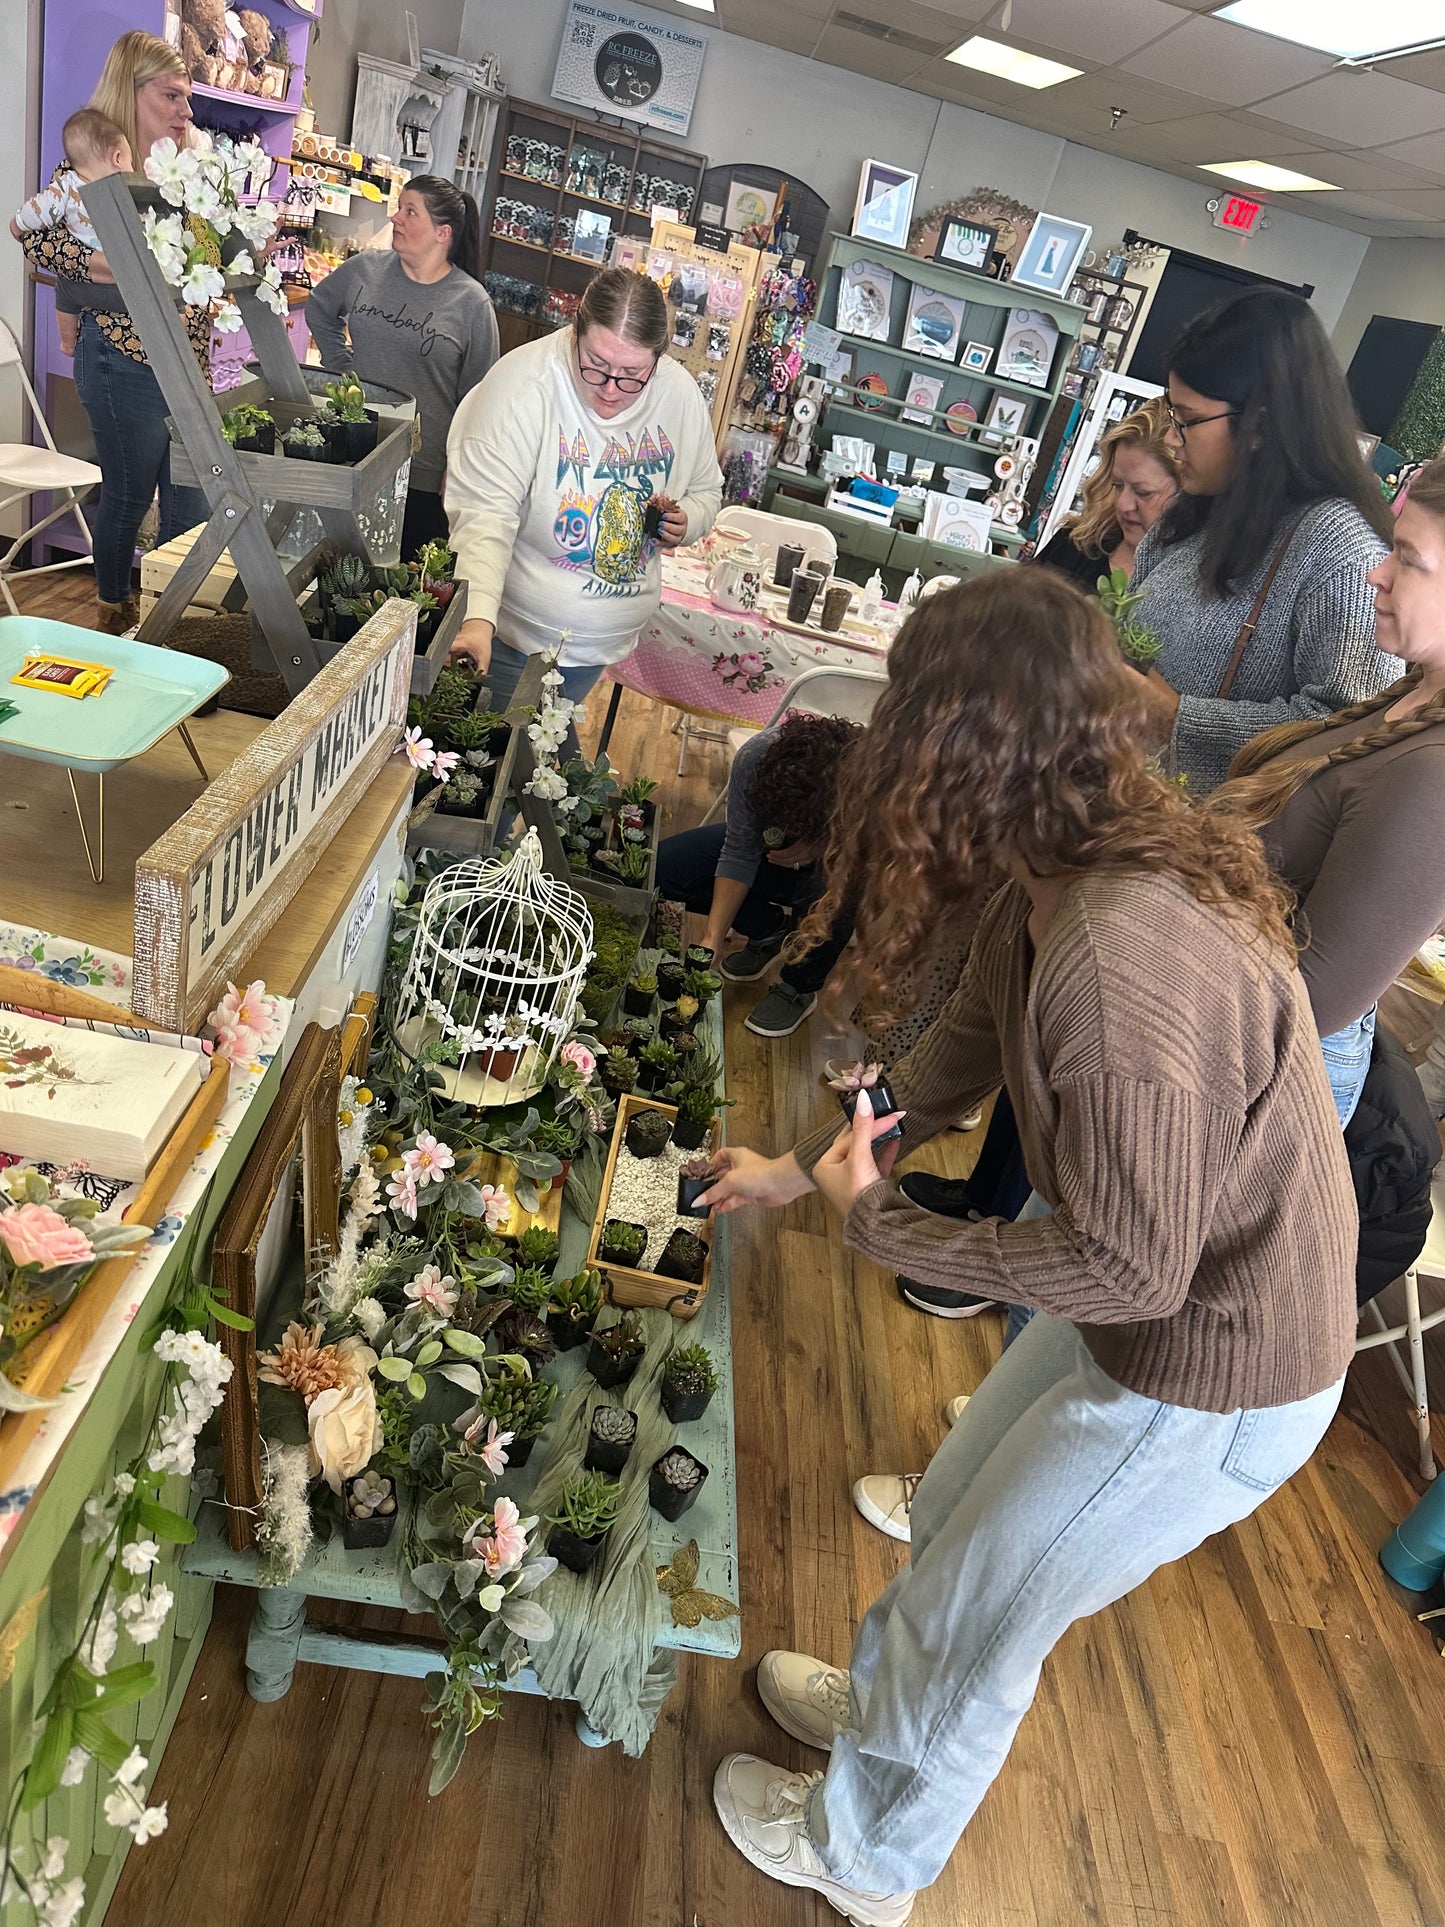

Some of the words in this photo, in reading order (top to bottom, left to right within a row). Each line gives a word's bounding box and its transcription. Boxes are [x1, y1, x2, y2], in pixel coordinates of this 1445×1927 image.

[573, 3, 597, 16] FREEZE
[597, 10, 617, 22] DRIED
[638, 22, 664, 37] CANDY,
[666, 31, 672, 39] &
[673, 33, 703, 48] DESSERTS
[608, 41, 621, 51] RC
[622, 45, 658, 63] FREEZE
[1222, 196, 1261, 232] EXIT
[350, 285, 455, 357] homebody
[799, 404, 810, 417] A
[556, 423, 592, 496] DEF
[311, 655, 390, 813] MARKET
